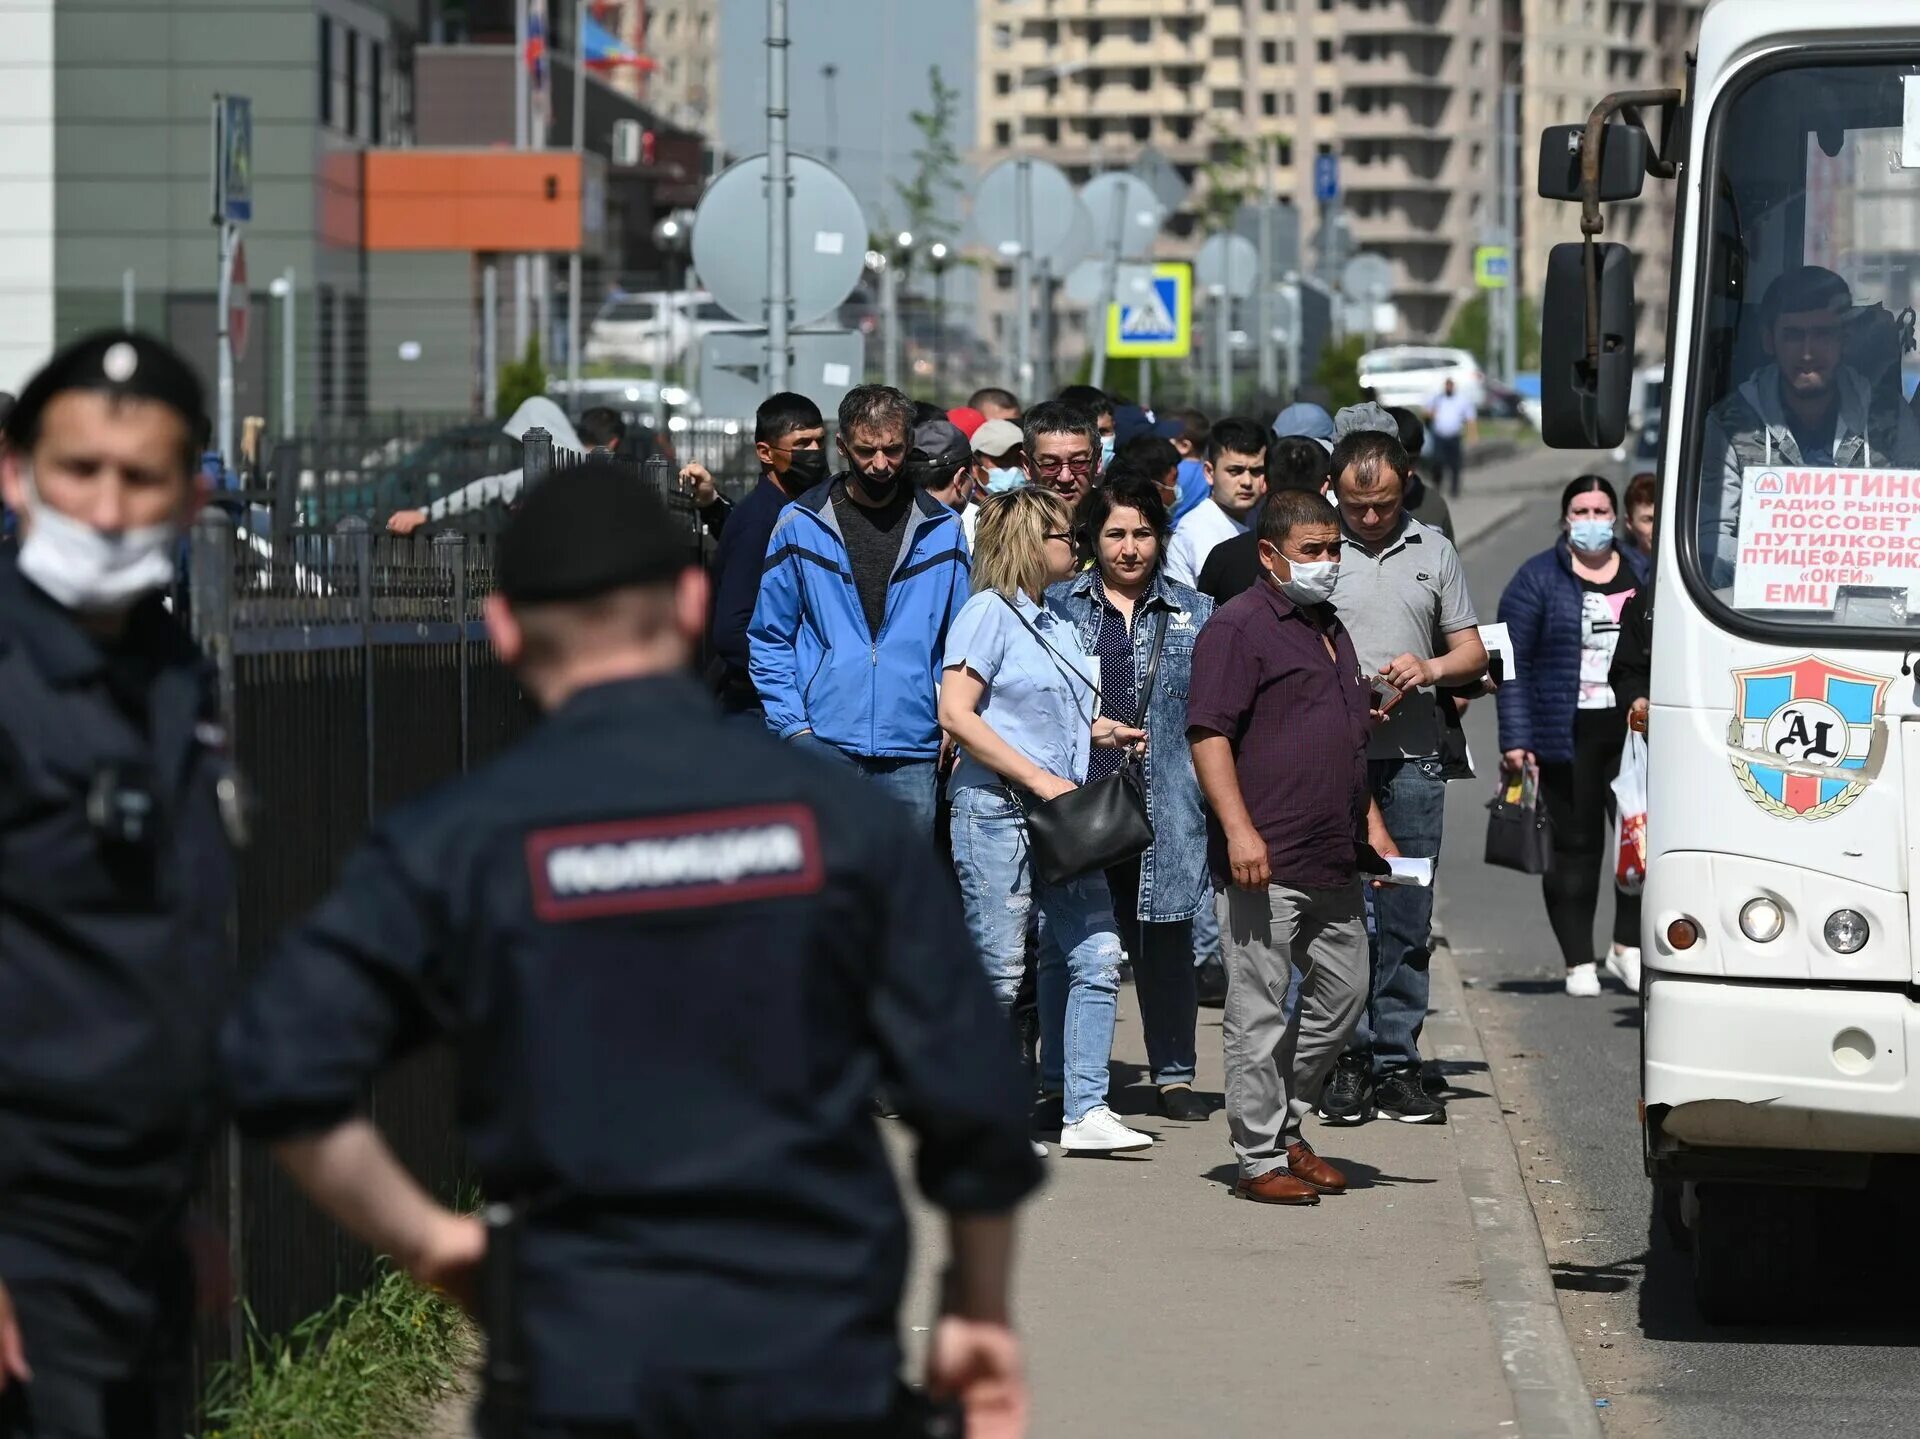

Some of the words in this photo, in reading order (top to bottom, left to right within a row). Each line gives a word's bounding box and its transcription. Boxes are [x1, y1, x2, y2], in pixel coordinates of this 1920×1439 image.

[1759, 499, 1836, 512] РАДИО
[1772, 514, 1912, 532] ПОССОВЕТ
[1765, 584, 1829, 607] ЕМЦ
[547, 823, 803, 894] ПОЛИЦИЯ
